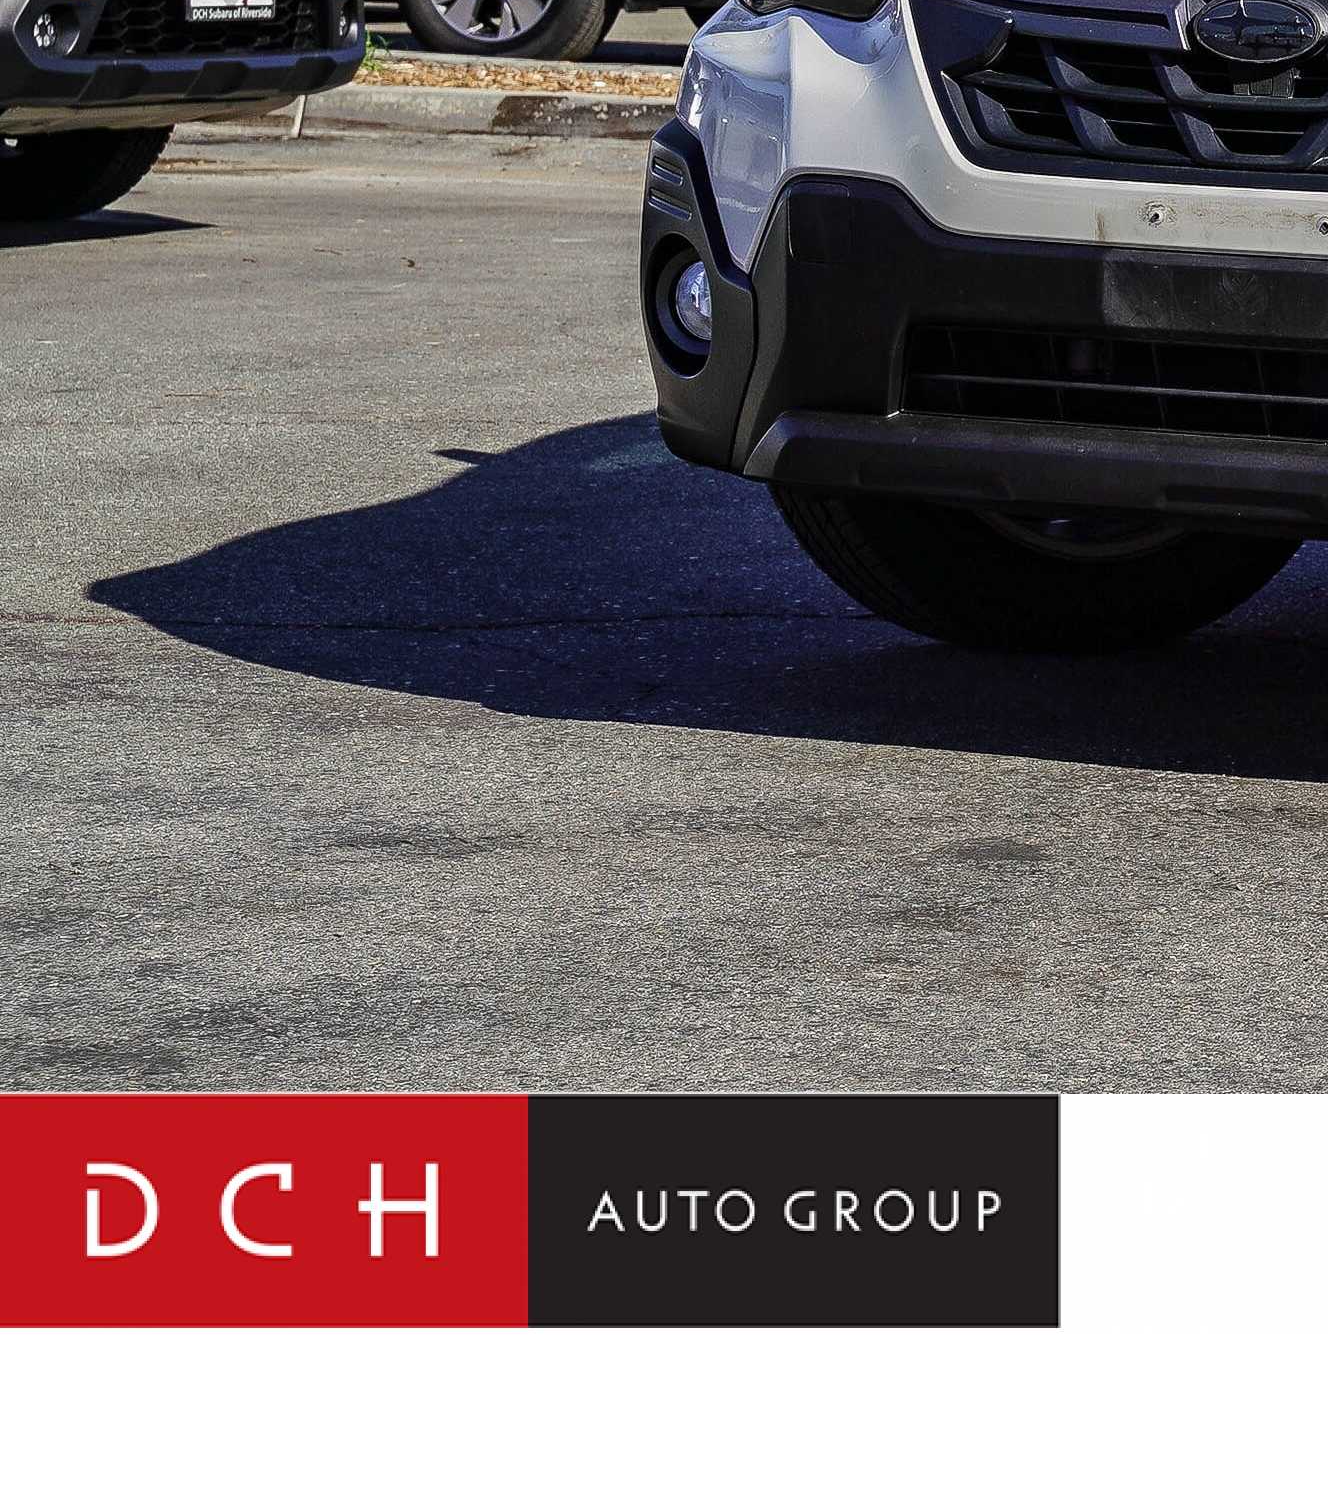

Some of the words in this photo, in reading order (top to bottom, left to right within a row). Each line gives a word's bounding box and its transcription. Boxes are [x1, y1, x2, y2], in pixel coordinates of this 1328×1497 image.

[192, 8, 208, 20] DCH
[209, 8, 233, 20] Subaru
[233, 7, 241, 19] of
[241, 6, 272, 19] Riverside
